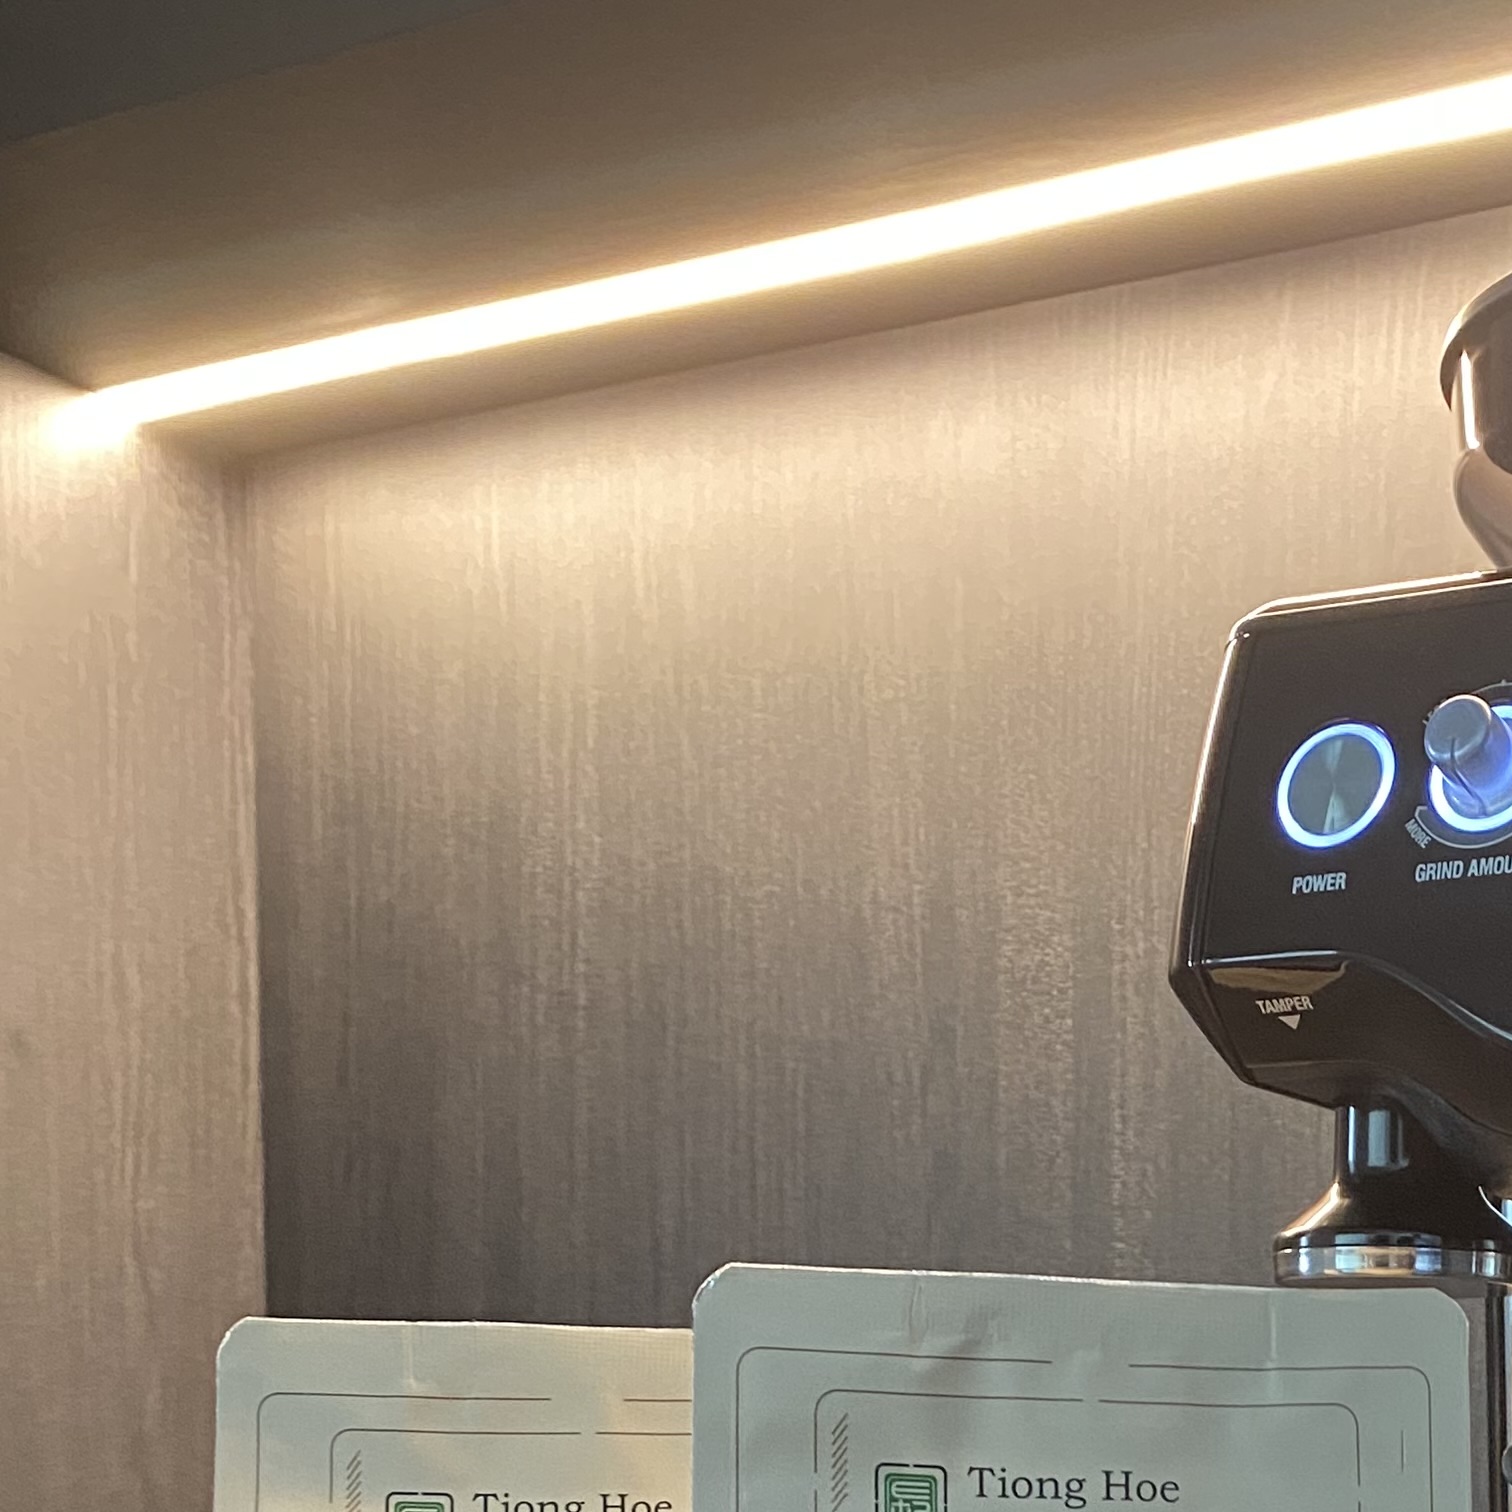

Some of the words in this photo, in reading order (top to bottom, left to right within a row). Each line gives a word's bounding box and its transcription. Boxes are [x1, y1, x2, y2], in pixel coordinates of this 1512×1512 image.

[1404, 818, 1432, 849] MORE
[1414, 858, 1464, 883] GRIND
[1291, 872, 1347, 896] POWER
[1256, 995, 1314, 1016] TAMPER
[968, 1466, 1087, 1508] Tiong
[1101, 1470, 1180, 1503] Hoe
